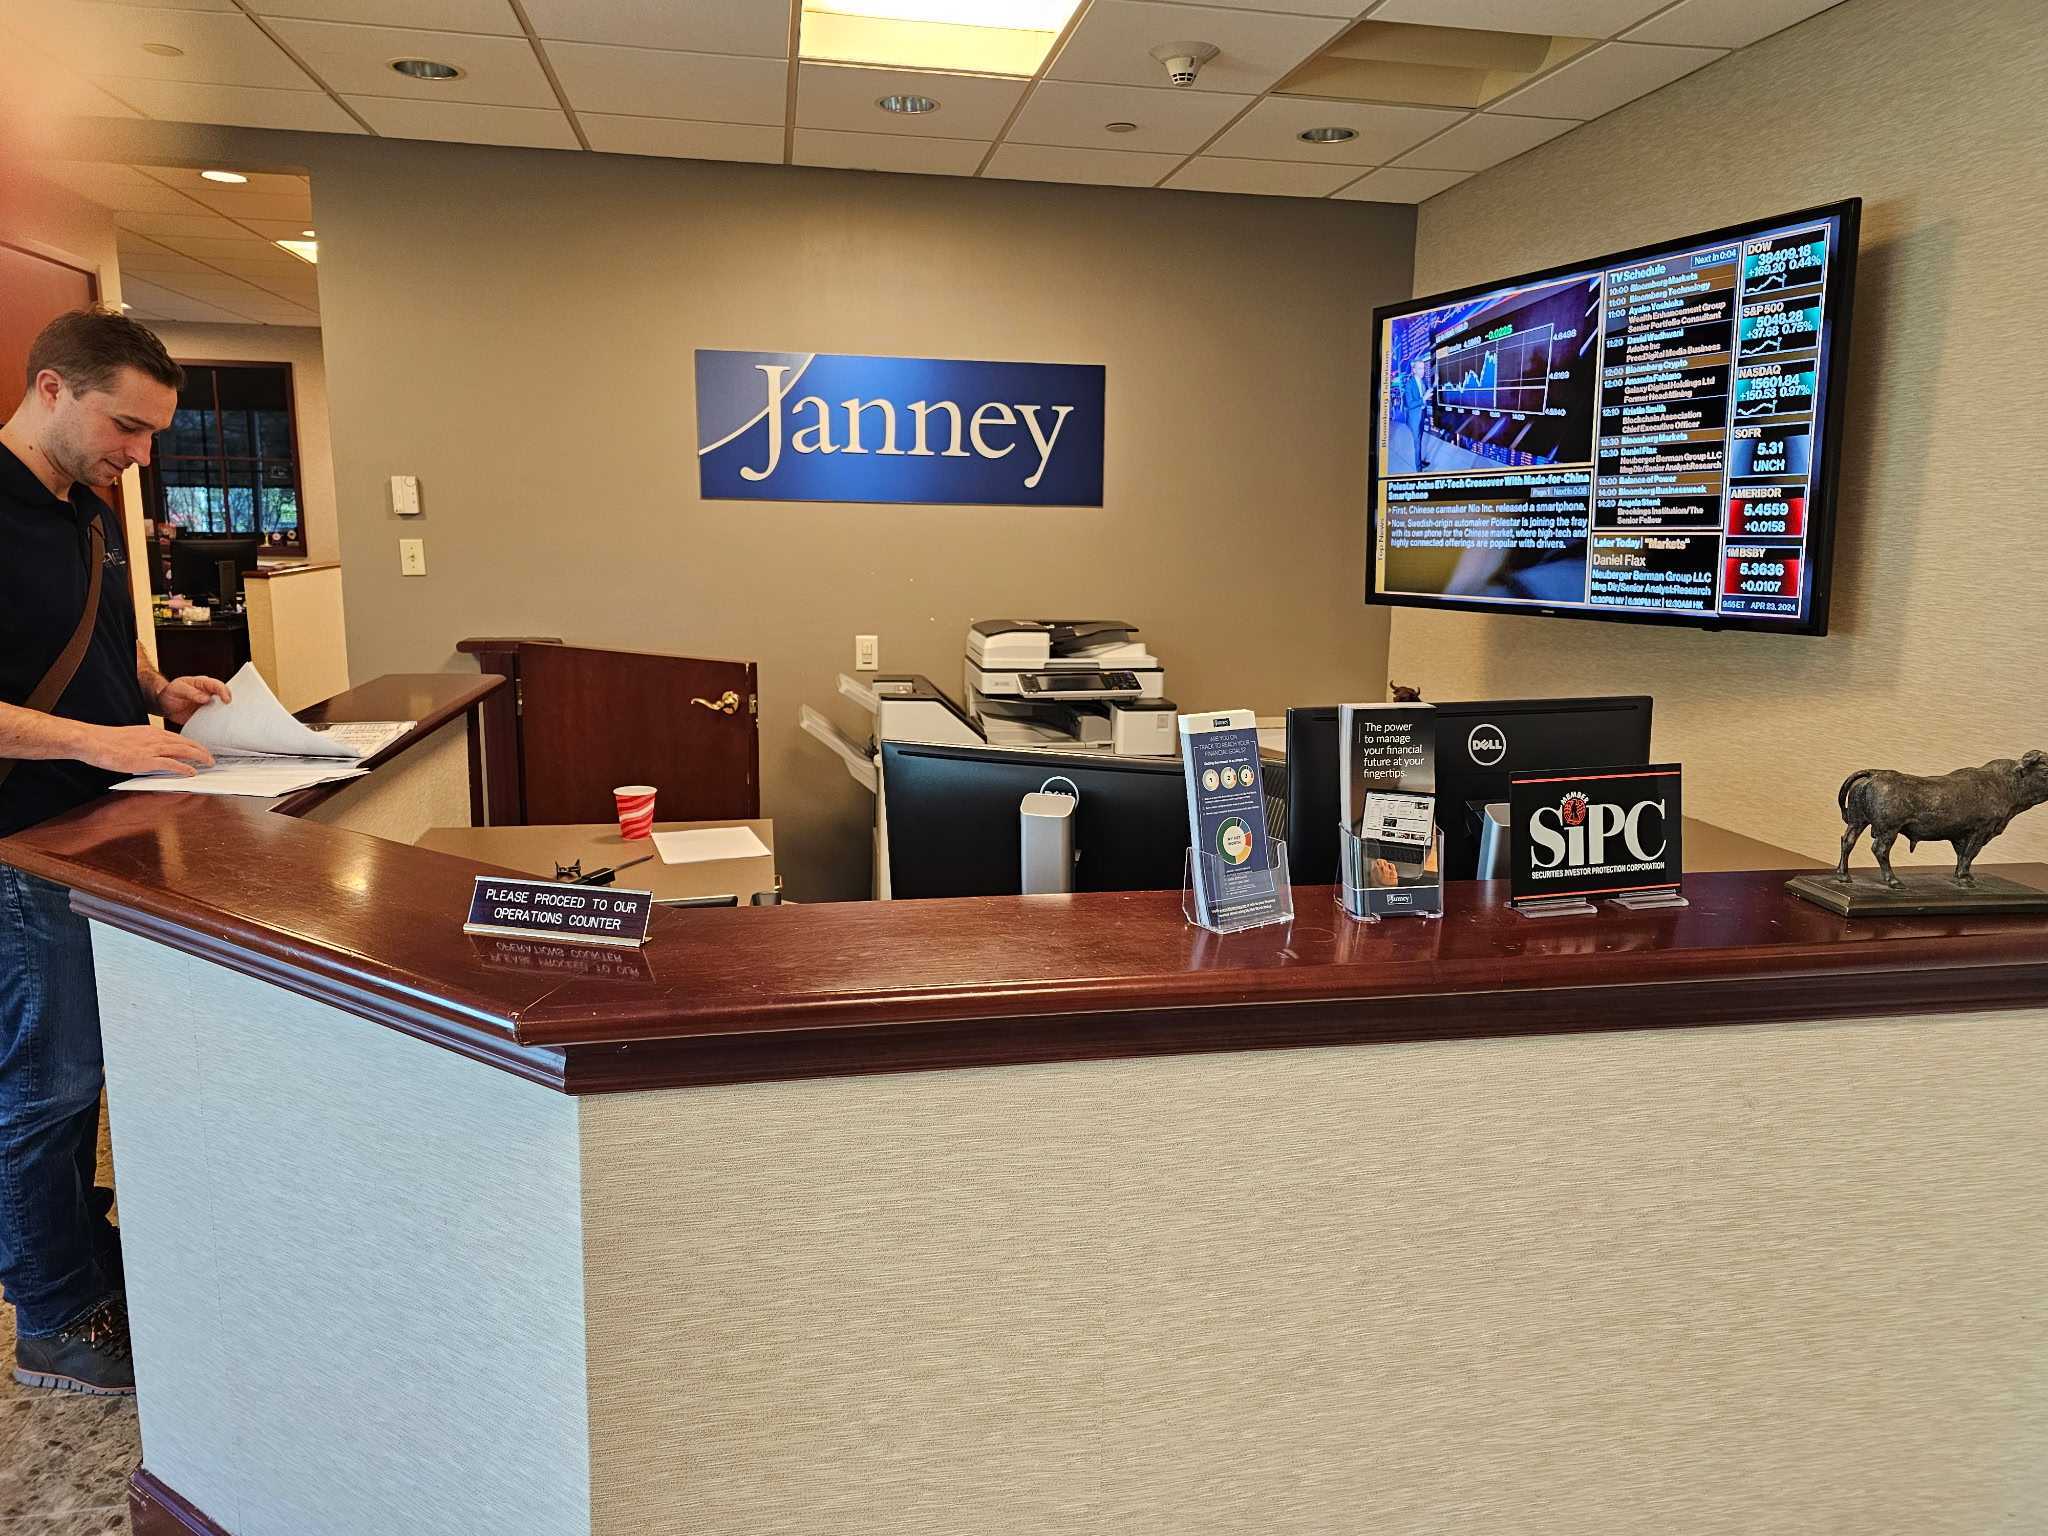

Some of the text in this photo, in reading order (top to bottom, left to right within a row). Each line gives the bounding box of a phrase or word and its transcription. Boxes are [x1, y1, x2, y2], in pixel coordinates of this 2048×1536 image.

[1748, 241, 1772, 254] DOW
[1758, 244, 1811, 265] 38409.18
[1694, 249, 1736, 265] Next 0:04
[1749, 255, 1821, 277] +169.20 0.44%
[1610, 264, 1666, 284] TV Schedule
[1609, 285, 1629, 296] 10:00
[1668, 282, 1711, 296] Technology
[1608, 308, 1626, 319] 11:00
[1628, 302, 1726, 324] Wealth Enhancement Group
[1744, 302, 1784, 317] S&P 500
[1628, 311, 1722, 334] Senior Portfolio Consultant
[1756, 309, 1804, 328] 5048.28
[1746, 320, 1812, 339] +37.68 0.75%
[1626, 342, 1660, 354] Adobe Inc
[1666, 343, 1721, 358] Media Business
[1664, 358, 1688, 370] Crypto
[1740, 365, 1782, 378] NASDAQ
[1624, 384, 1648, 395] Galaxy
[1702, 376, 1716, 385] Ltd
[1750, 374, 1800, 391] 15601.84
[1624, 394, 1648, 404] Former
[1740, 384, 1810, 400] +150.53 0.97%
[1602, 408, 1620, 416] 12:10
[1622, 410, 1702, 425] Blockchain Association
[740, 364, 1074, 489] Janney
[1622, 420, 1700, 434] Chief Executive Officer
[1734, 428, 1762, 438] SOFR
[1757, 440, 1784, 456] 5.31
[1620, 451, 1722, 466] Neuberger Berman Group LLC
[1753, 458, 1786, 472] UNCH
[1504, 475, 1523, 486] With
[1524, 472, 1590, 486] Made-for-China
[1731, 487, 1782, 498] AMERIBOR
[1408, 504, 1435, 514] Chinese
[1468, 504, 1480, 513] Nio
[1495, 502, 1529, 512] released
[1536, 500, 1587, 514] smartphone.
[1744, 502, 1789, 516] 5.4559
[1521, 516, 1528, 526] is
[1529, 516, 1556, 528] joining
[1556, 516, 1570, 526] the
[1570, 516, 1588, 528] fray
[1617, 516, 1662, 524] Senior Fellow
[1744, 520, 1786, 532] +0.0158
[1516, 528, 1537, 538] where
[1538, 528, 1572, 540] high-tech
[1572, 528, 1588, 538] and
[1490, 540, 1517, 548] popular
[1518, 539, 1536, 548] with
[1536, 539, 1566, 548] drivers.
[1594, 538, 1640, 550] Later Today
[1740, 548, 1766, 558] BSBY
[1594, 554, 1646, 567] Daniel Flax
[1740, 562, 1784, 576] 5.3636
[1592, 569, 1712, 584] Neuberger Berman Group LLC
[1740, 580, 1782, 592] +0.0107
[1750, 602, 1796, 612] APR 2024
[1365, 722, 1413, 734] The power
[1364, 734, 1411, 745] to manage
[1472, 738, 1502, 750] DELL
[1364, 744, 1423, 756] your financial
[1364, 756, 1424, 768] future at your
[1364, 768, 1408, 780] fingertips.
[1560, 791, 1590, 806] MEMBER
[1532, 862, 1665, 880] SECURITIES INVESTOR PROTECTION CORPORATION
[486, 888, 637, 914] PLEASE PROCEED TO OUR
[494, 908, 622, 930] OPERATIONS COUNTER
